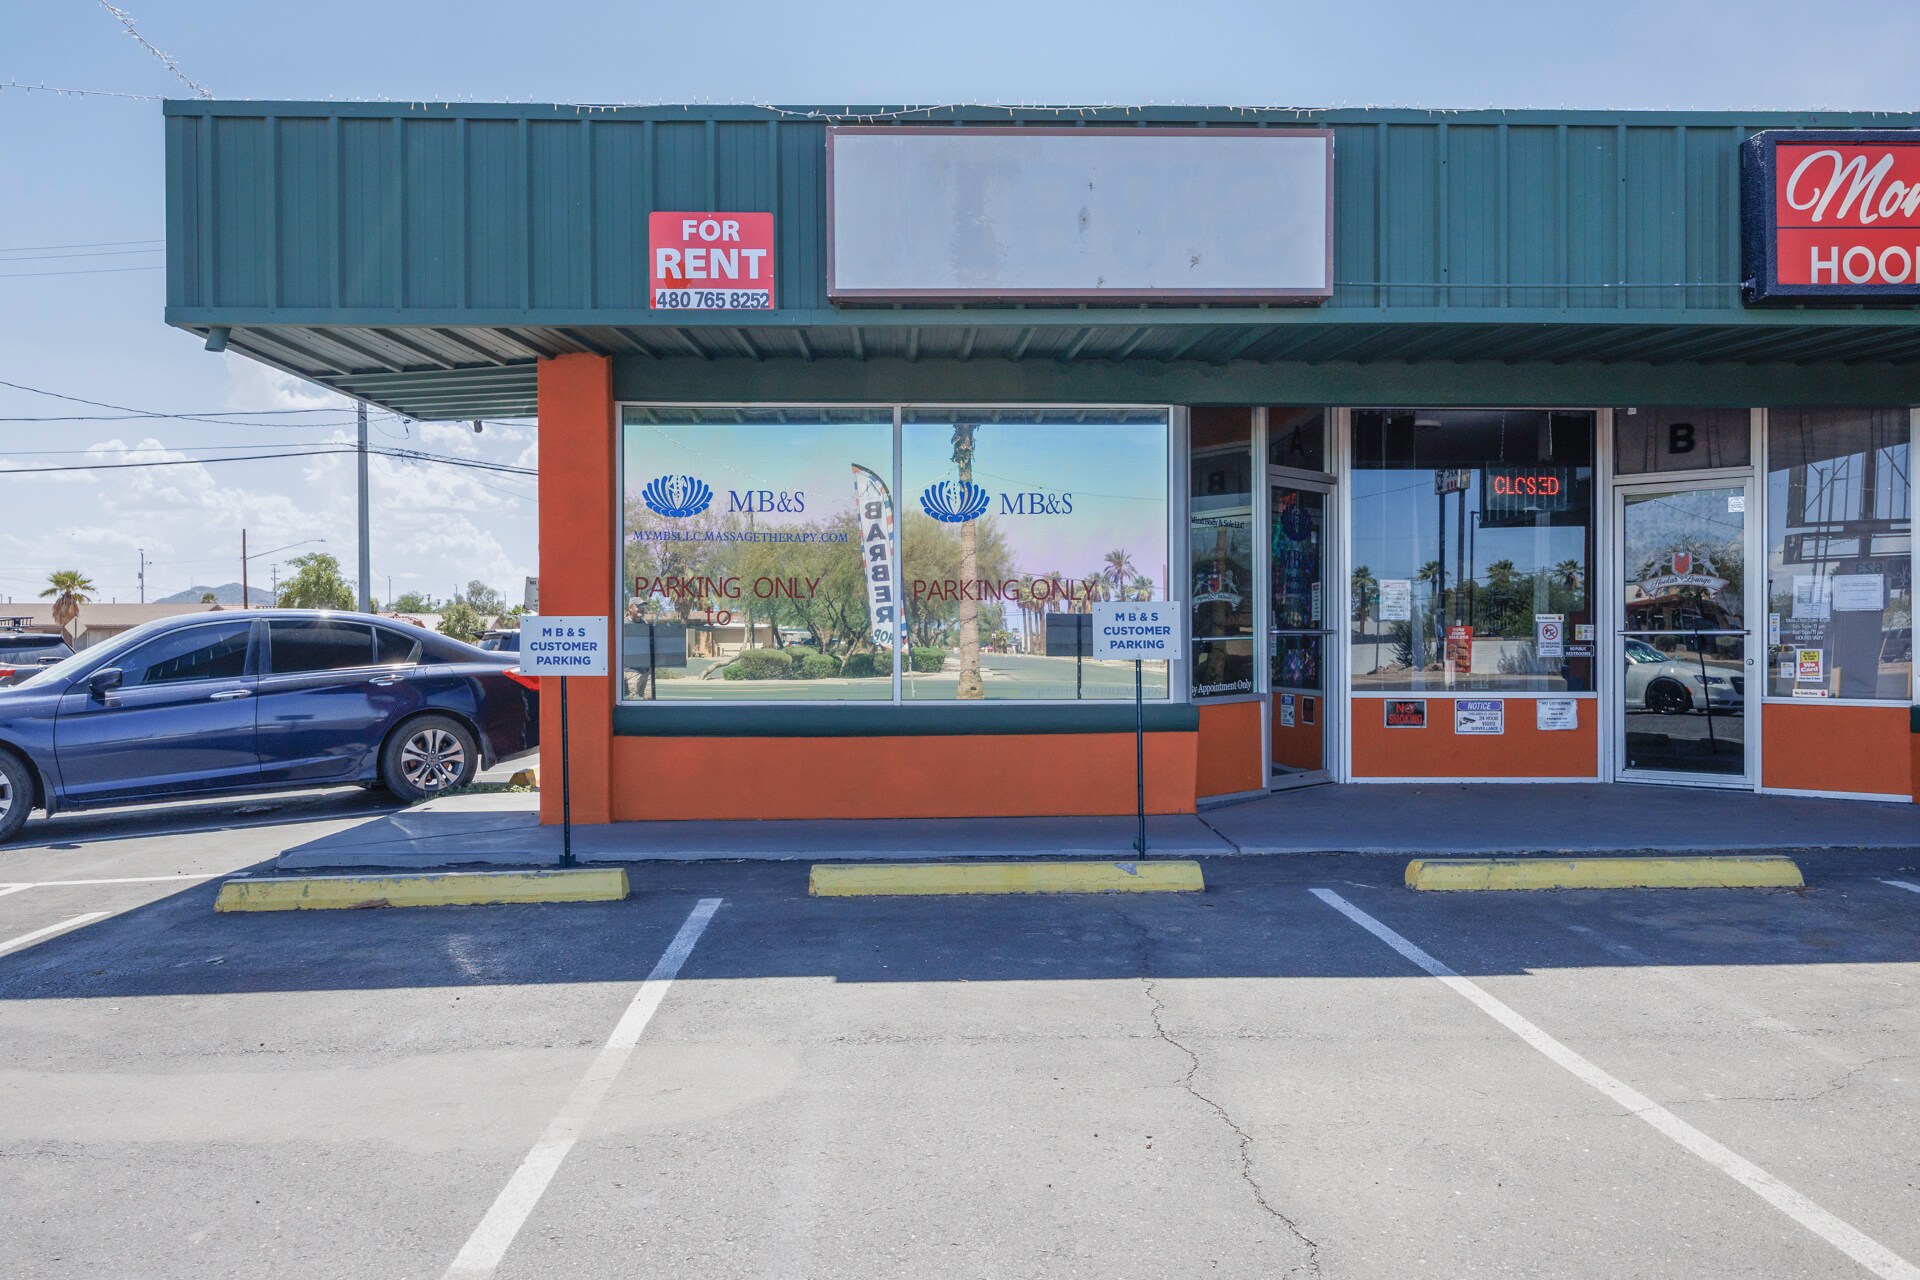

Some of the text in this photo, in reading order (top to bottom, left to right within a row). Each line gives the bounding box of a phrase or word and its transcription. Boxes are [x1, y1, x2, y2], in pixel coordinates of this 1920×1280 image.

[682, 220, 740, 241] FOR
[656, 248, 767, 279] RENT
[1811, 246, 1920, 283] HOO
[657, 291, 770, 309] 480 765 8252
[1669, 423, 1695, 454] B
[1494, 476, 1559, 494] CLOSED
[728, 490, 805, 513] MB&S
[1000, 493, 1073, 515] MB&S
[635, 577, 820, 598] PARKING ONLY
[913, 579, 1097, 601] PARKING ONLY
[1684, 577, 1712, 586] Lounge
[705, 606, 731, 625] to
[1103, 626, 1171, 635] CUSTOMER
[530, 642, 597, 651] CUSTOMER
[1110, 640, 1164, 649] PARKING
[537, 656, 591, 665] PARKING
[1198, 681, 1236, 695] Appointment
[1237, 679, 1251, 690] Only
[1467, 702, 1491, 710] NOTICE
[1388, 713, 1422, 725] SMOKING
